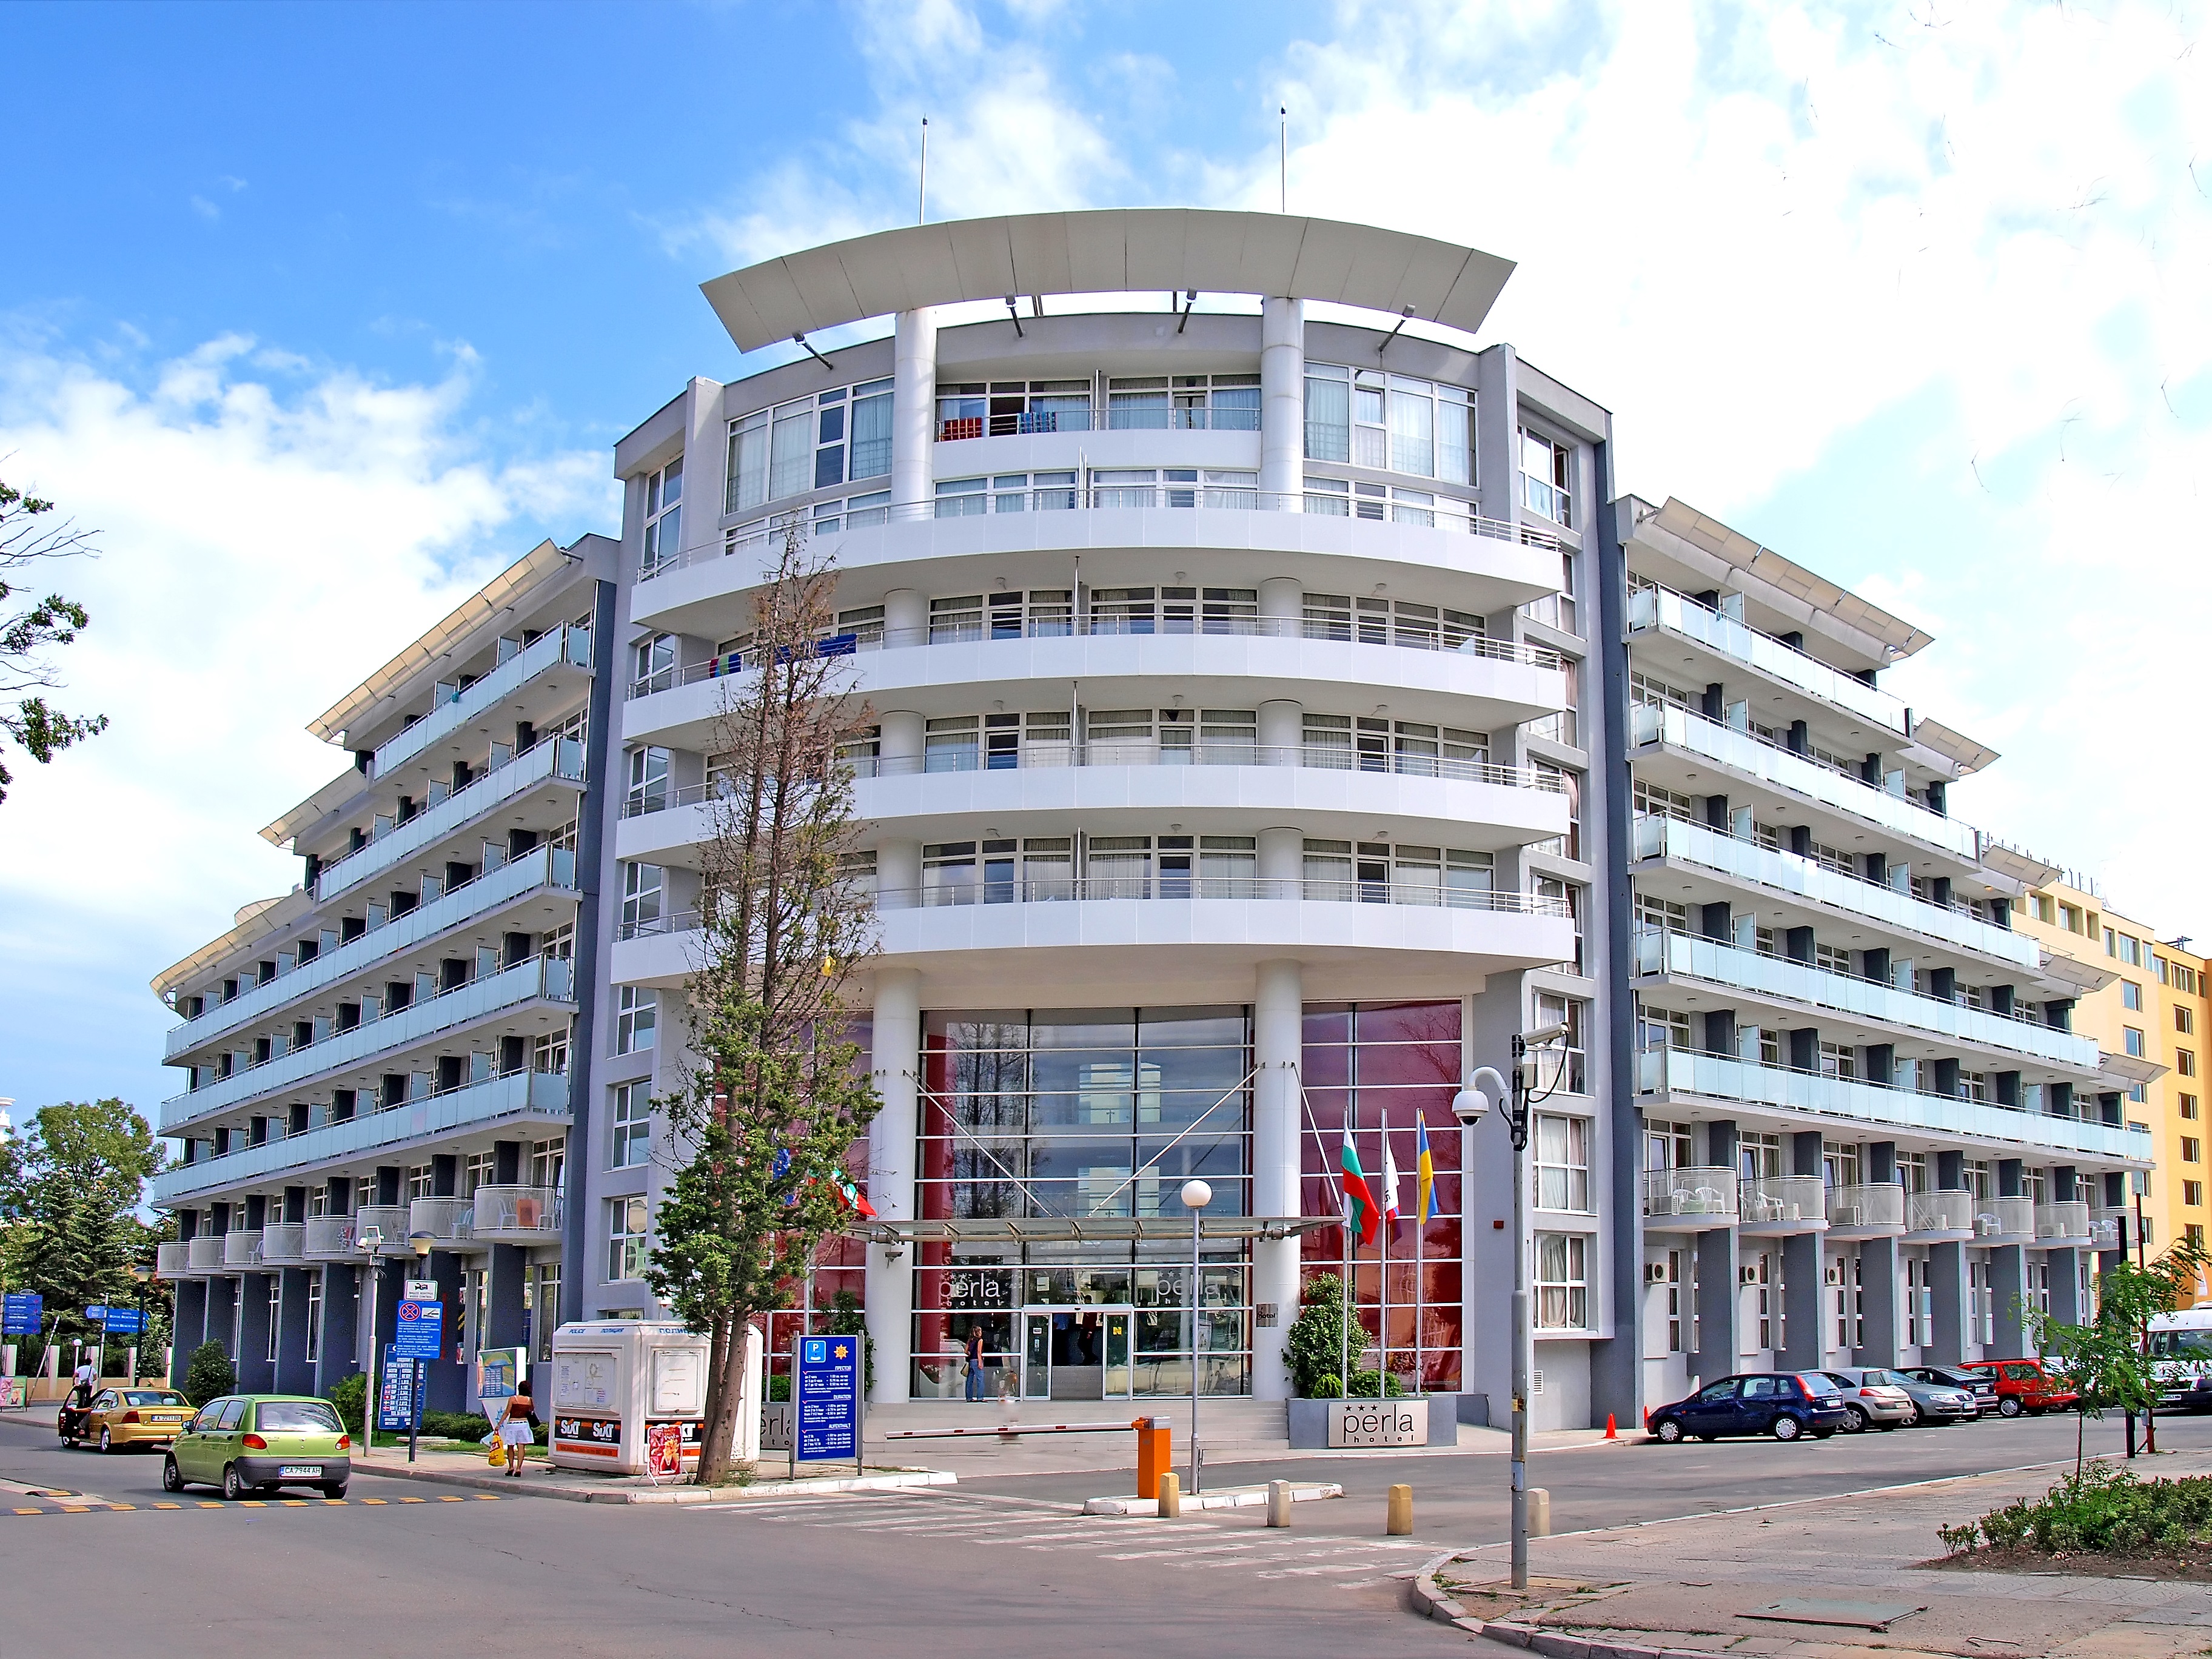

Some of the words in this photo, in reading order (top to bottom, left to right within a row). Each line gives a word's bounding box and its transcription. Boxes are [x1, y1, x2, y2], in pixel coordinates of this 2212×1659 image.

[938, 1272, 1000, 1306] perla
[1343, 1404, 1414, 1443] perla
[1354, 1435, 1414, 1443] hotel
